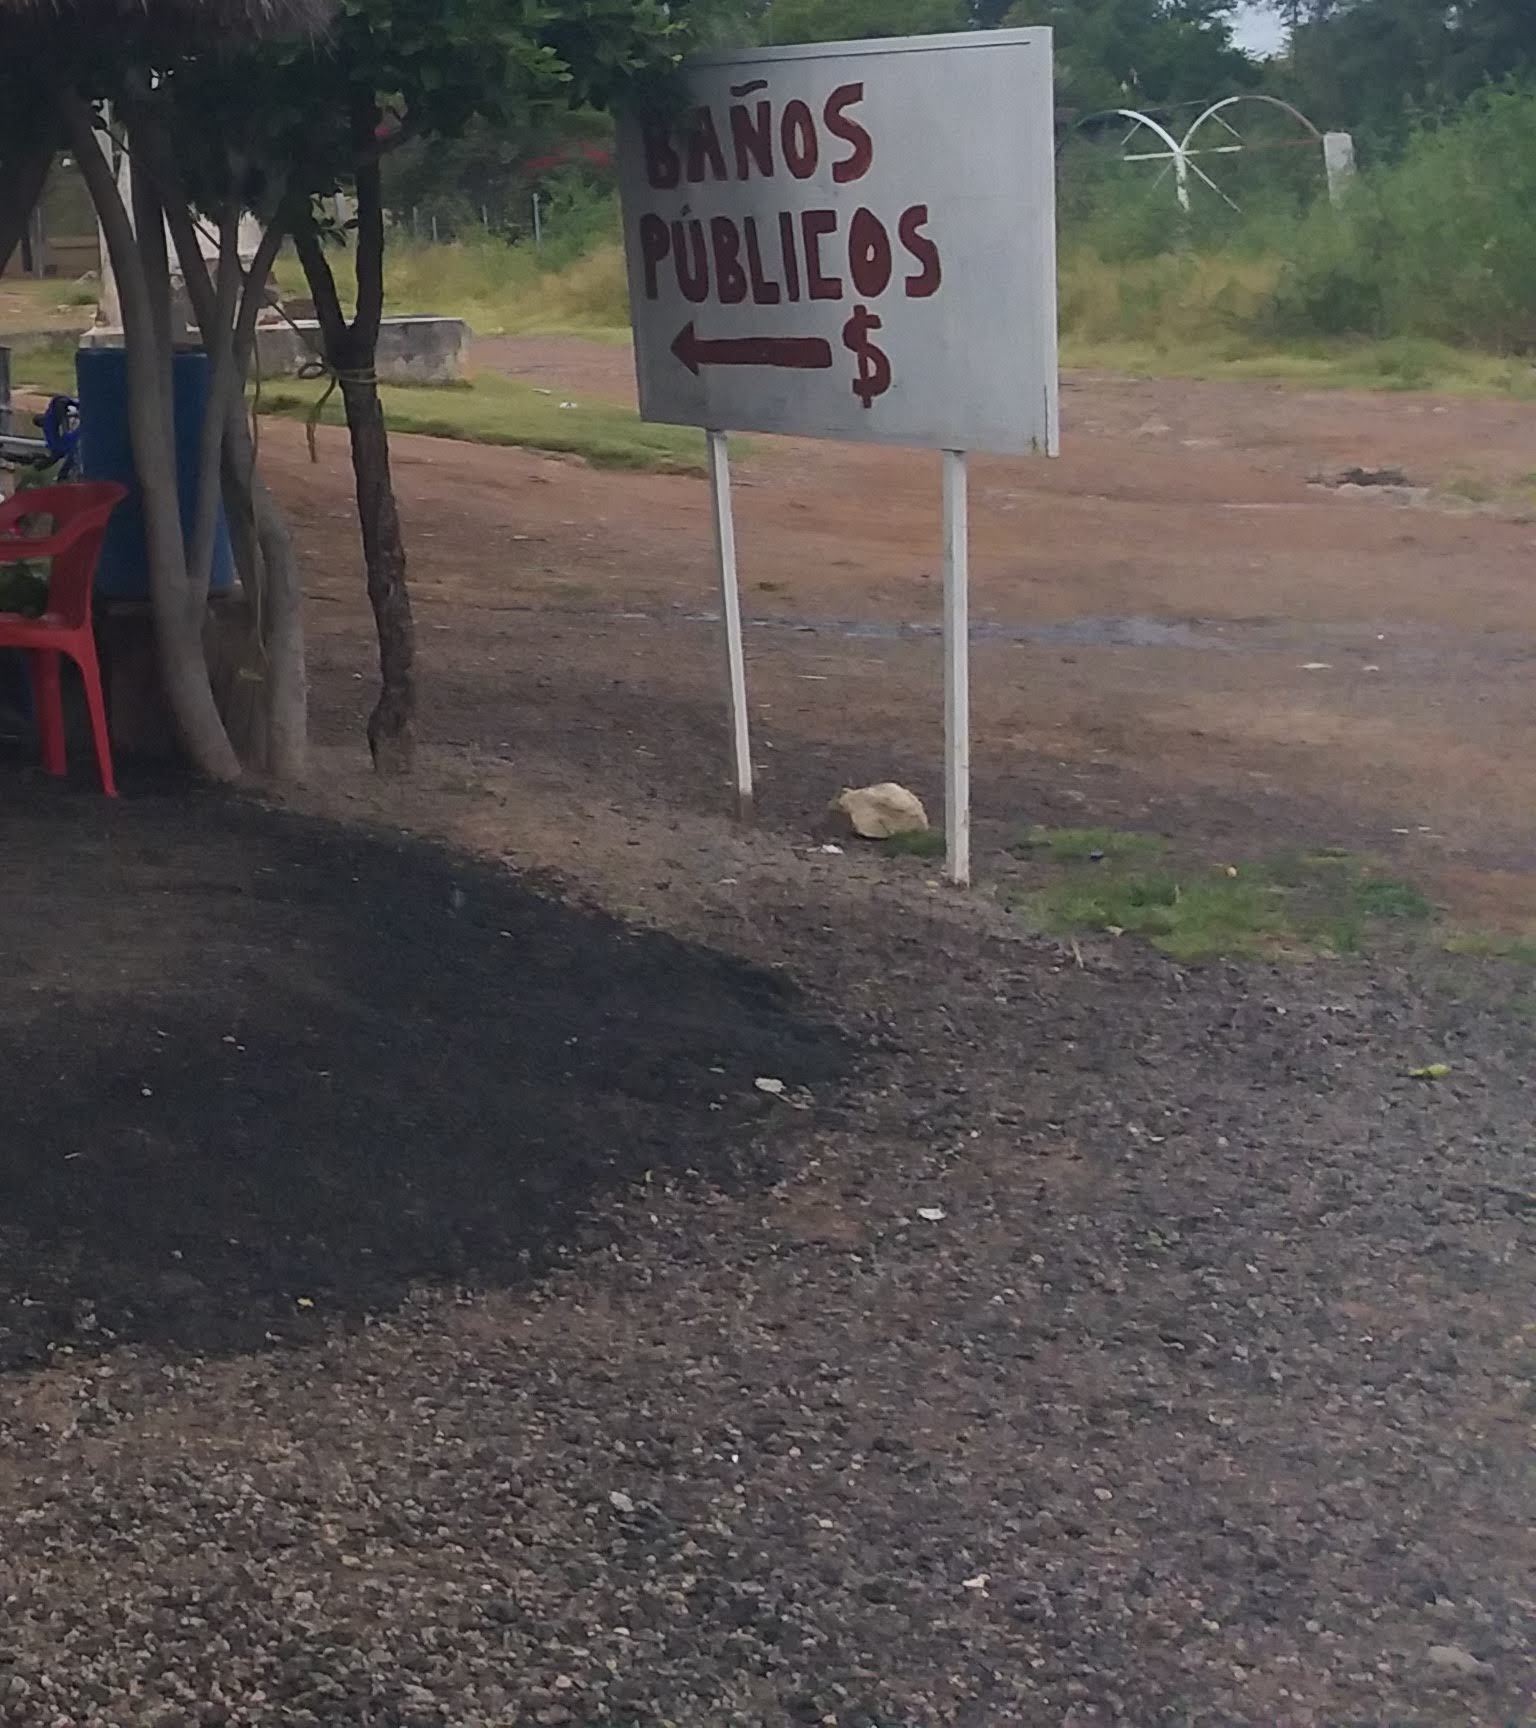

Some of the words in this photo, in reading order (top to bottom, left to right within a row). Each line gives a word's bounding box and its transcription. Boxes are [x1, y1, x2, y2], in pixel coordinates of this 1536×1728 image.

[641, 79, 873, 190] BAÑOS
[639, 204, 942, 305] PÚBLICOS
[842, 304, 892, 408] $
